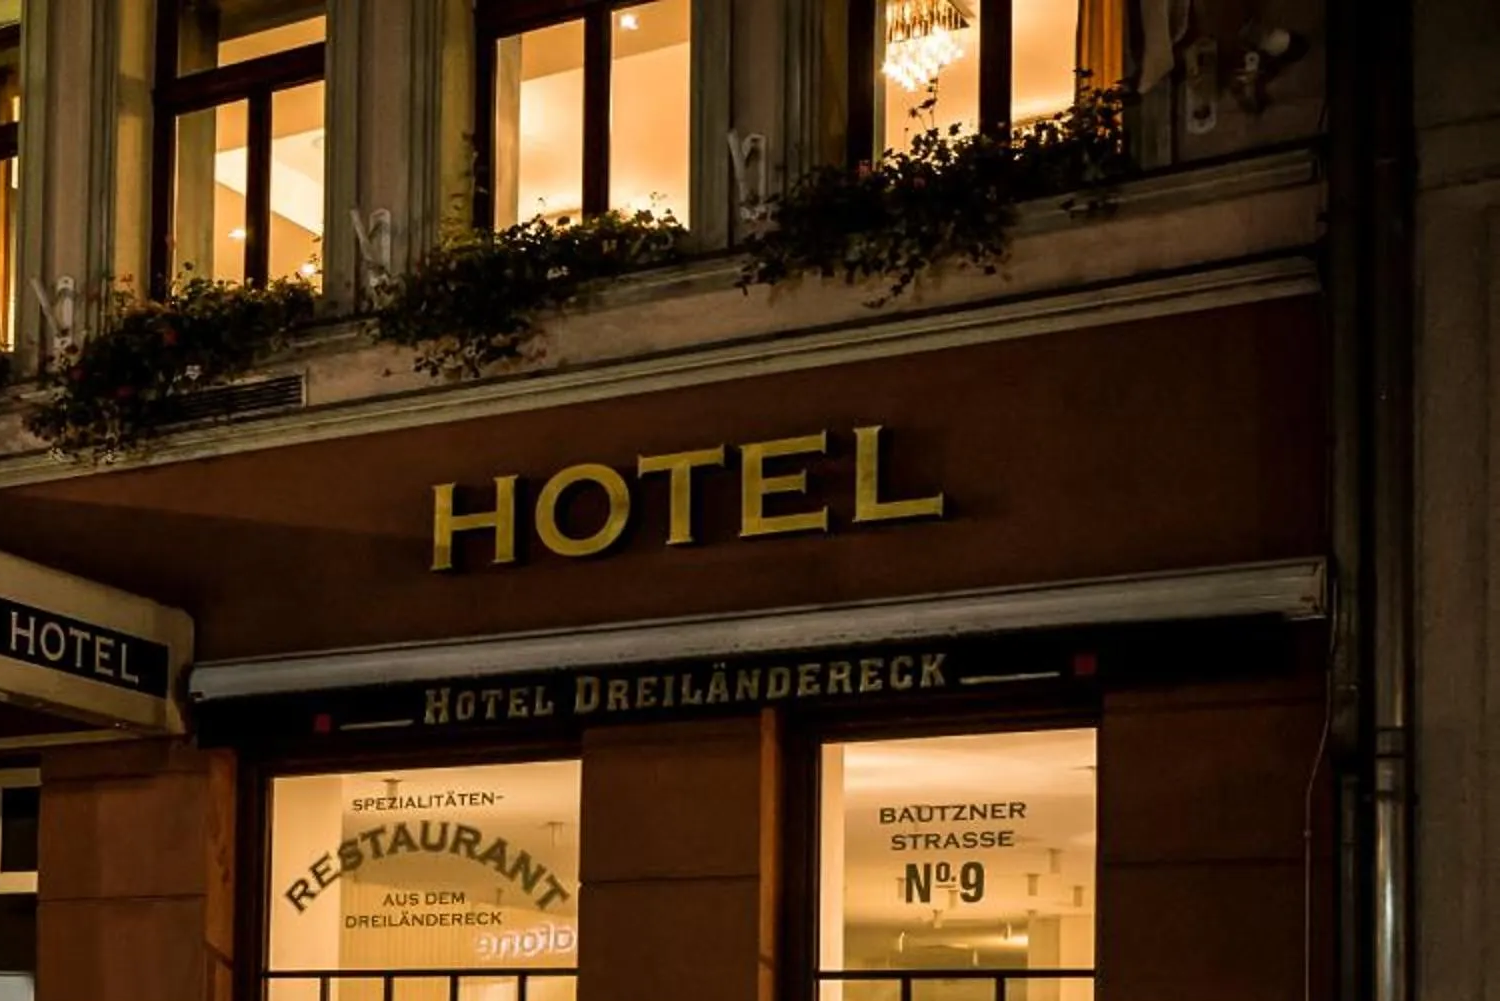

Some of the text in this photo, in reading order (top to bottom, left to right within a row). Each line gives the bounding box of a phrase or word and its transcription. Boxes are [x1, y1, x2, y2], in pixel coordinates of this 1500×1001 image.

[431, 425, 945, 572] HOTEL
[10, 611, 140, 685] HOTEL
[423, 653, 949, 725] HOTEL DREILÄNDERECK
[351, 790, 505, 813] SPEZIALITÄTEN-
[879, 802, 1026, 825] BAUTZNER
[890, 830, 1015, 851] STRASSE
[284, 819, 571, 914] RESTAURANT
[382, 891, 466, 907] AUS DEM
[344, 910, 503, 929] DREILÄNDERECK
